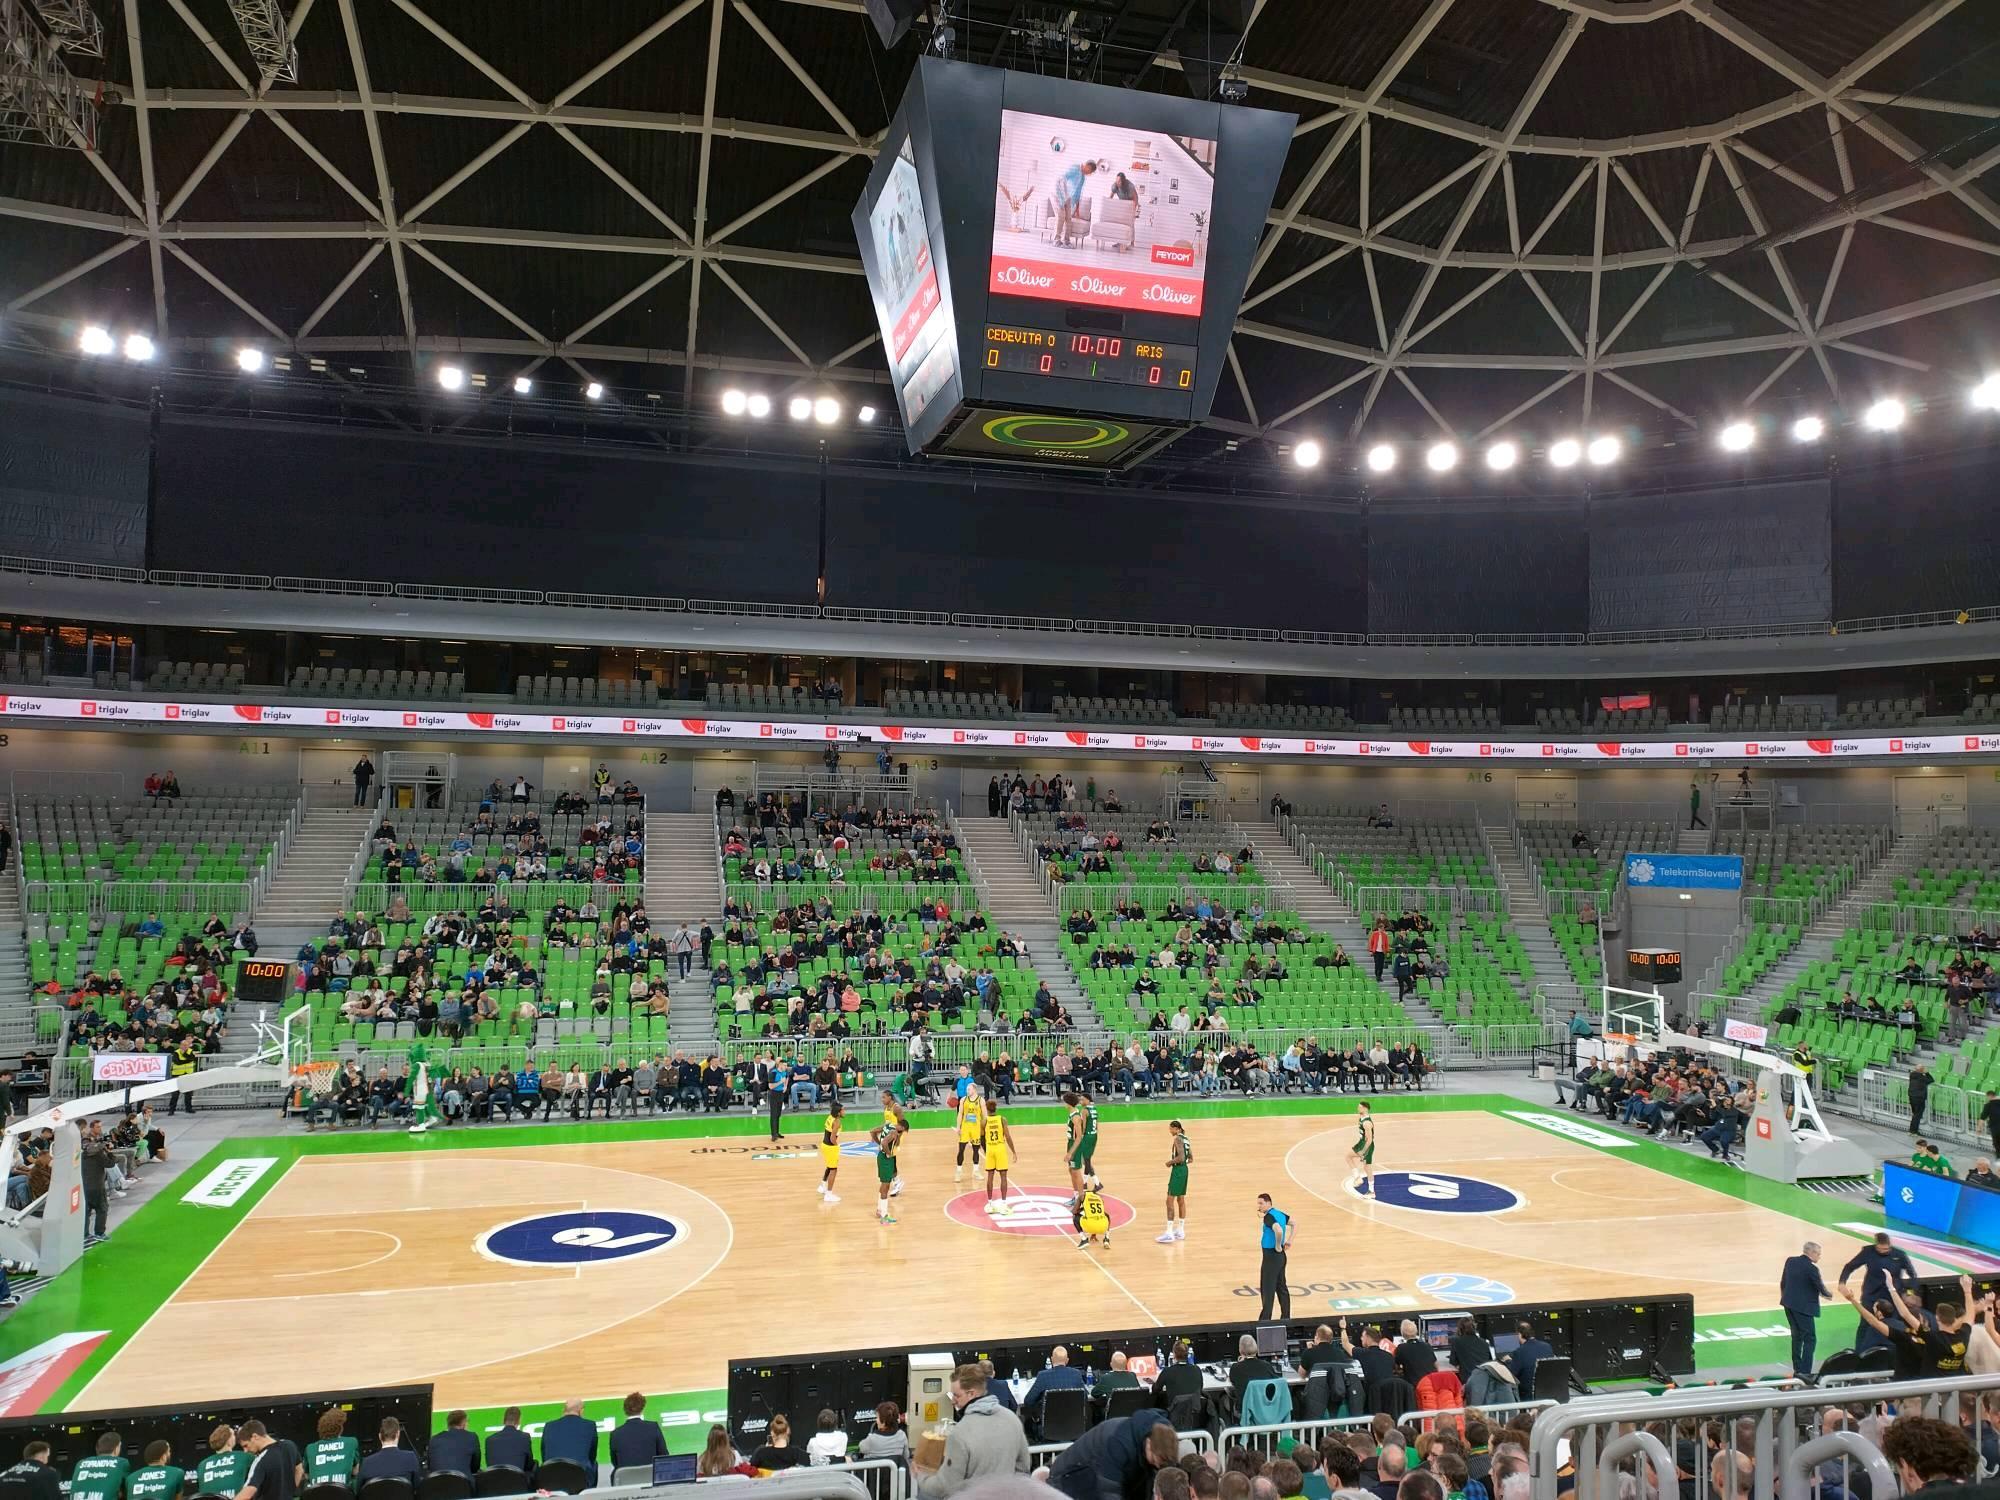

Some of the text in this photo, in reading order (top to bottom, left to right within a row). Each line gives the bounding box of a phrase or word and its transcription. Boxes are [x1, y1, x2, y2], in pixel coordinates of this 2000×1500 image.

[1155, 251, 1191, 262] FEYDOM
[997, 266, 1054, 288] s.Oliver
[1070, 275, 1126, 296] s.Oliver
[1142, 284, 1196, 305] s.Oliver
[987, 328, 1042, 345] CEDEVITA
[1136, 345, 1164, 359] ARIS
[987, 349, 999, 366] 0
[1040, 355, 1052, 372] 0
[1149, 366, 1161, 384] 0
[1179, 369, 1191, 387] 0
[9, 702, 41, 711] triglav
[99, 706, 128, 715] triglav
[182, 709, 209, 718] triglav
[264, 712, 291, 721] triglav
[342, 714, 369, 723] triglav
[419, 717, 444, 726] triglav
[495, 719, 520, 728] triglav
[567, 721, 591, 729] triglav
[637, 723, 661, 731] triglav
[707, 725, 730, 734] triglav
[774, 728, 796, 736] triglav
[905, 732, 926, 740] triglav
[967, 734, 987, 742] triglav
[1028, 735, 1048, 743] triglav
[1089, 737, 1109, 745] triglav
[1147, 739, 1167, 747] triglav
[1204, 741, 1223, 749] triglav
[1317, 744, 1335, 752] triglav
[1431, 746, 1452, 754] triglav
[1760, 746, 1785, 754] triglav
[1834, 744, 1858, 752] triglav
[1905, 742, 1930, 750] triglav
[1493, 747, 1514, 755] triglav
[1556, 747, 1577, 755] triglav
[1622, 747, 1645, 755] triglav
[1690, 747, 1714, 755] triglav
[1659, 867, 1741, 880] TelekomSlovenije
[246, 963, 284, 977] 10:00
[100, 1058, 161, 1078] CEDEVITA
[1089, 1202, 1103, 1215] 55
[1232, 1280, 1403, 1298] EuroCp
[318, 1441, 345, 1452] DANEU
[138, 1470, 167, 1482] JONES
